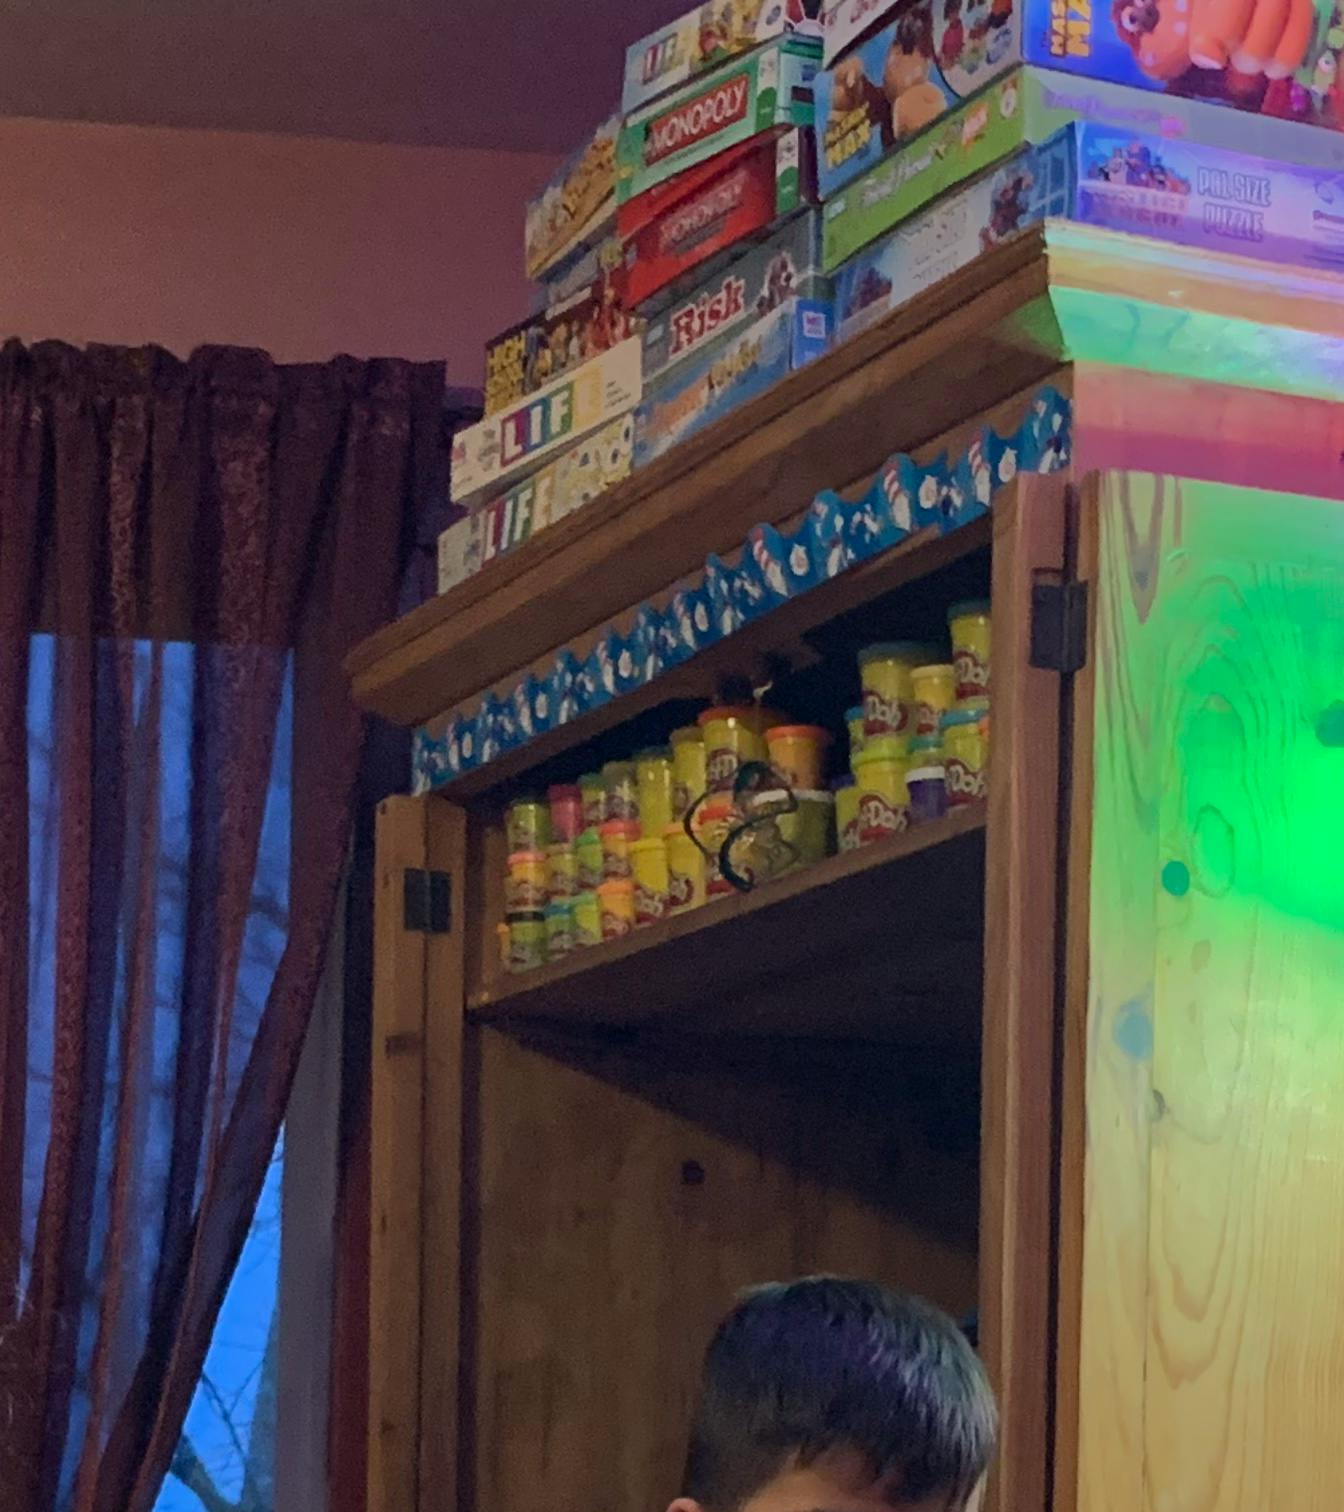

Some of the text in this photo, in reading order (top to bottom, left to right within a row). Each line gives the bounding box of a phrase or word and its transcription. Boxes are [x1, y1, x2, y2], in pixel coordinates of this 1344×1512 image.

[648, 79, 747, 158] MONOPOLY
[1197, 166, 1272, 207] PAL SIZE
[1202, 202, 1265, 243] PUZZLE
